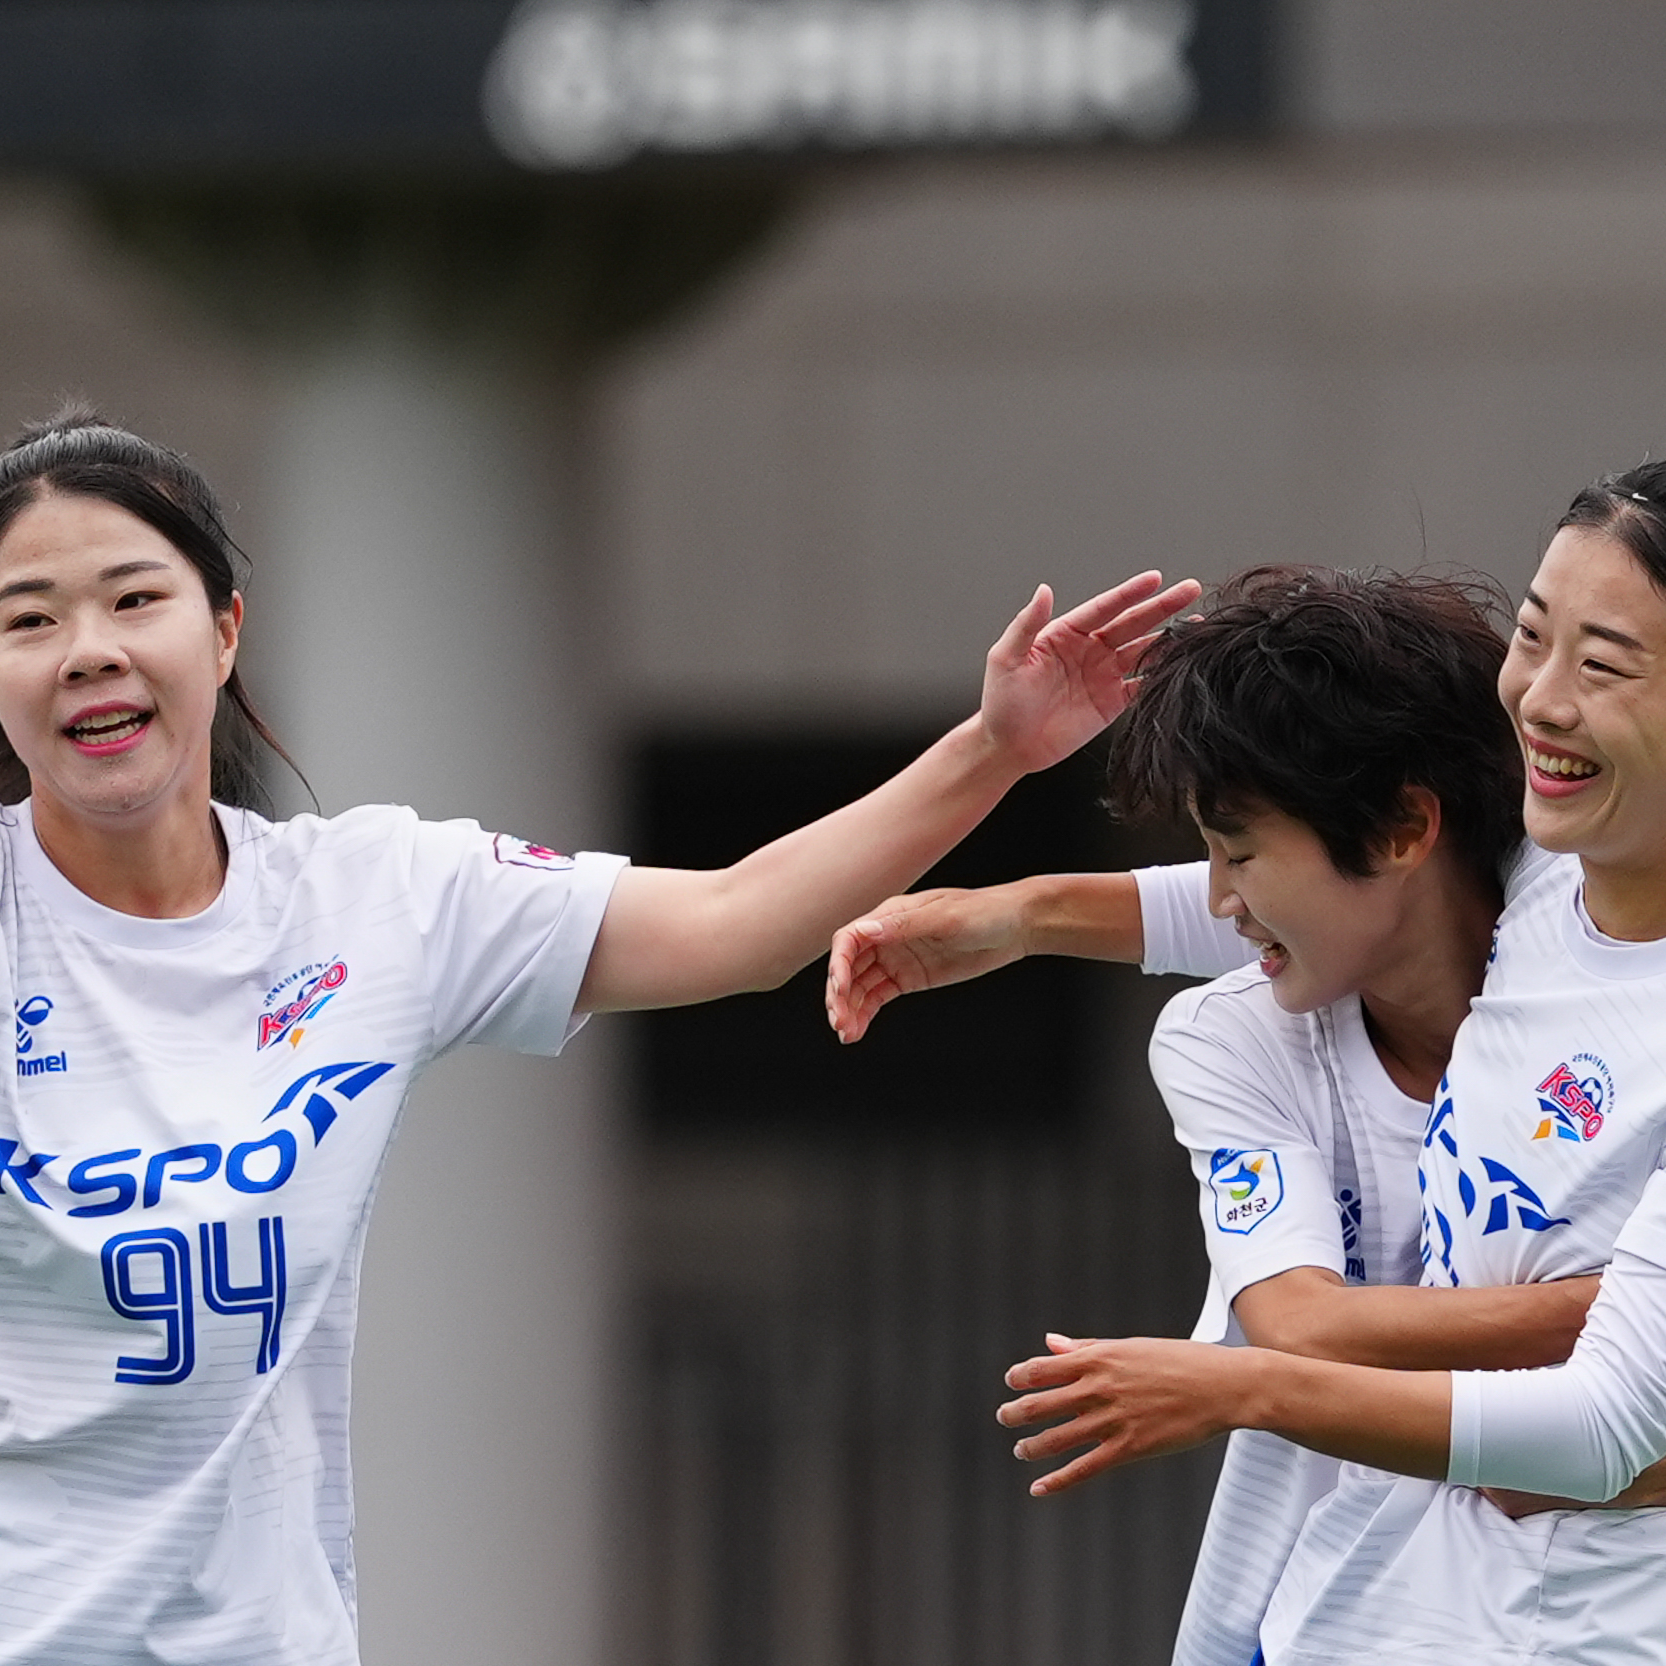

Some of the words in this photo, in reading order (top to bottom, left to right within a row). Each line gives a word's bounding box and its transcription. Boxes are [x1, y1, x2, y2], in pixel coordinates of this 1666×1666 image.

[16, 1050, 67, 1077] mmel
[1534, 1061, 1605, 1143] KSPO
[1226, 1196, 1269, 1223] 화천군
[100, 1215, 287, 1386] 94
